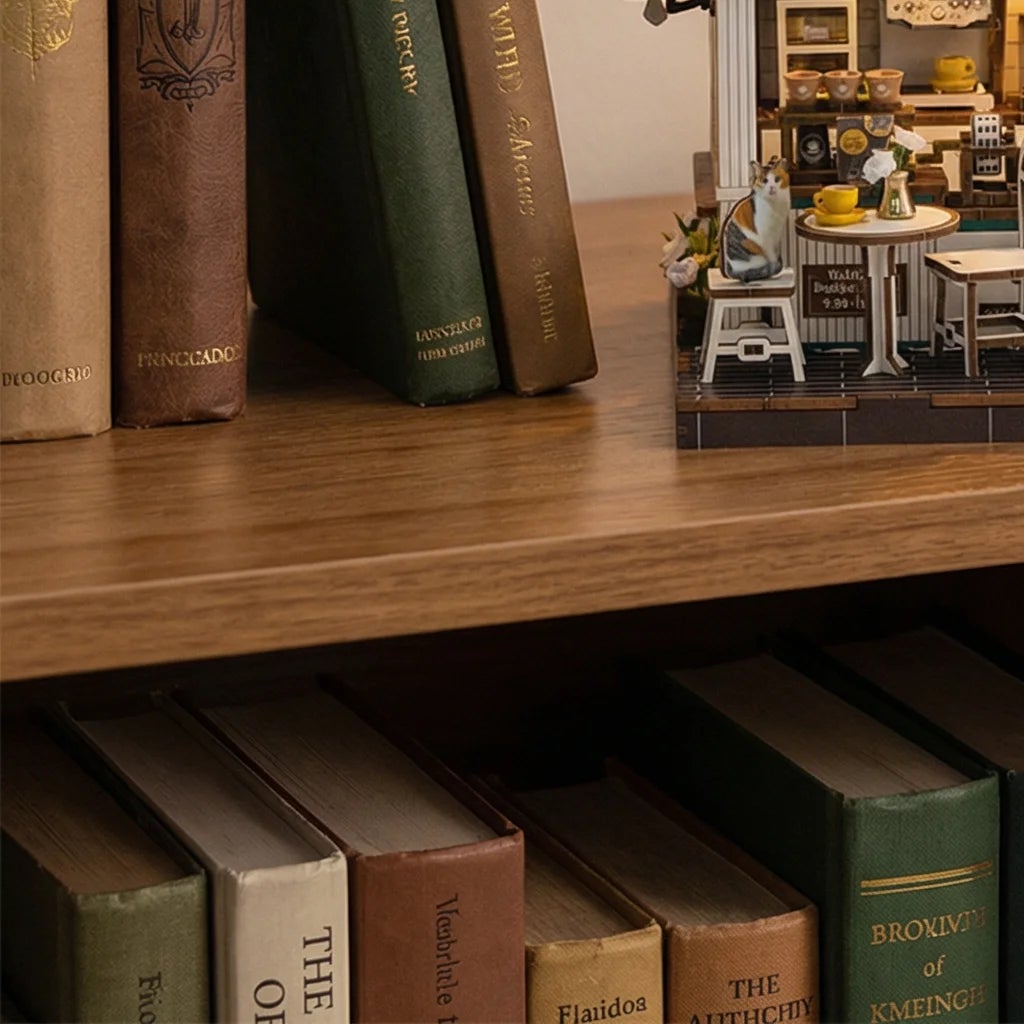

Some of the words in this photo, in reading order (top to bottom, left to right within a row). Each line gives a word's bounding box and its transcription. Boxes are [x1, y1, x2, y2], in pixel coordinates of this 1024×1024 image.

[302, 926, 334, 1014] THE
[923, 954, 946, 976] of
[729, 974, 780, 1000] THE
